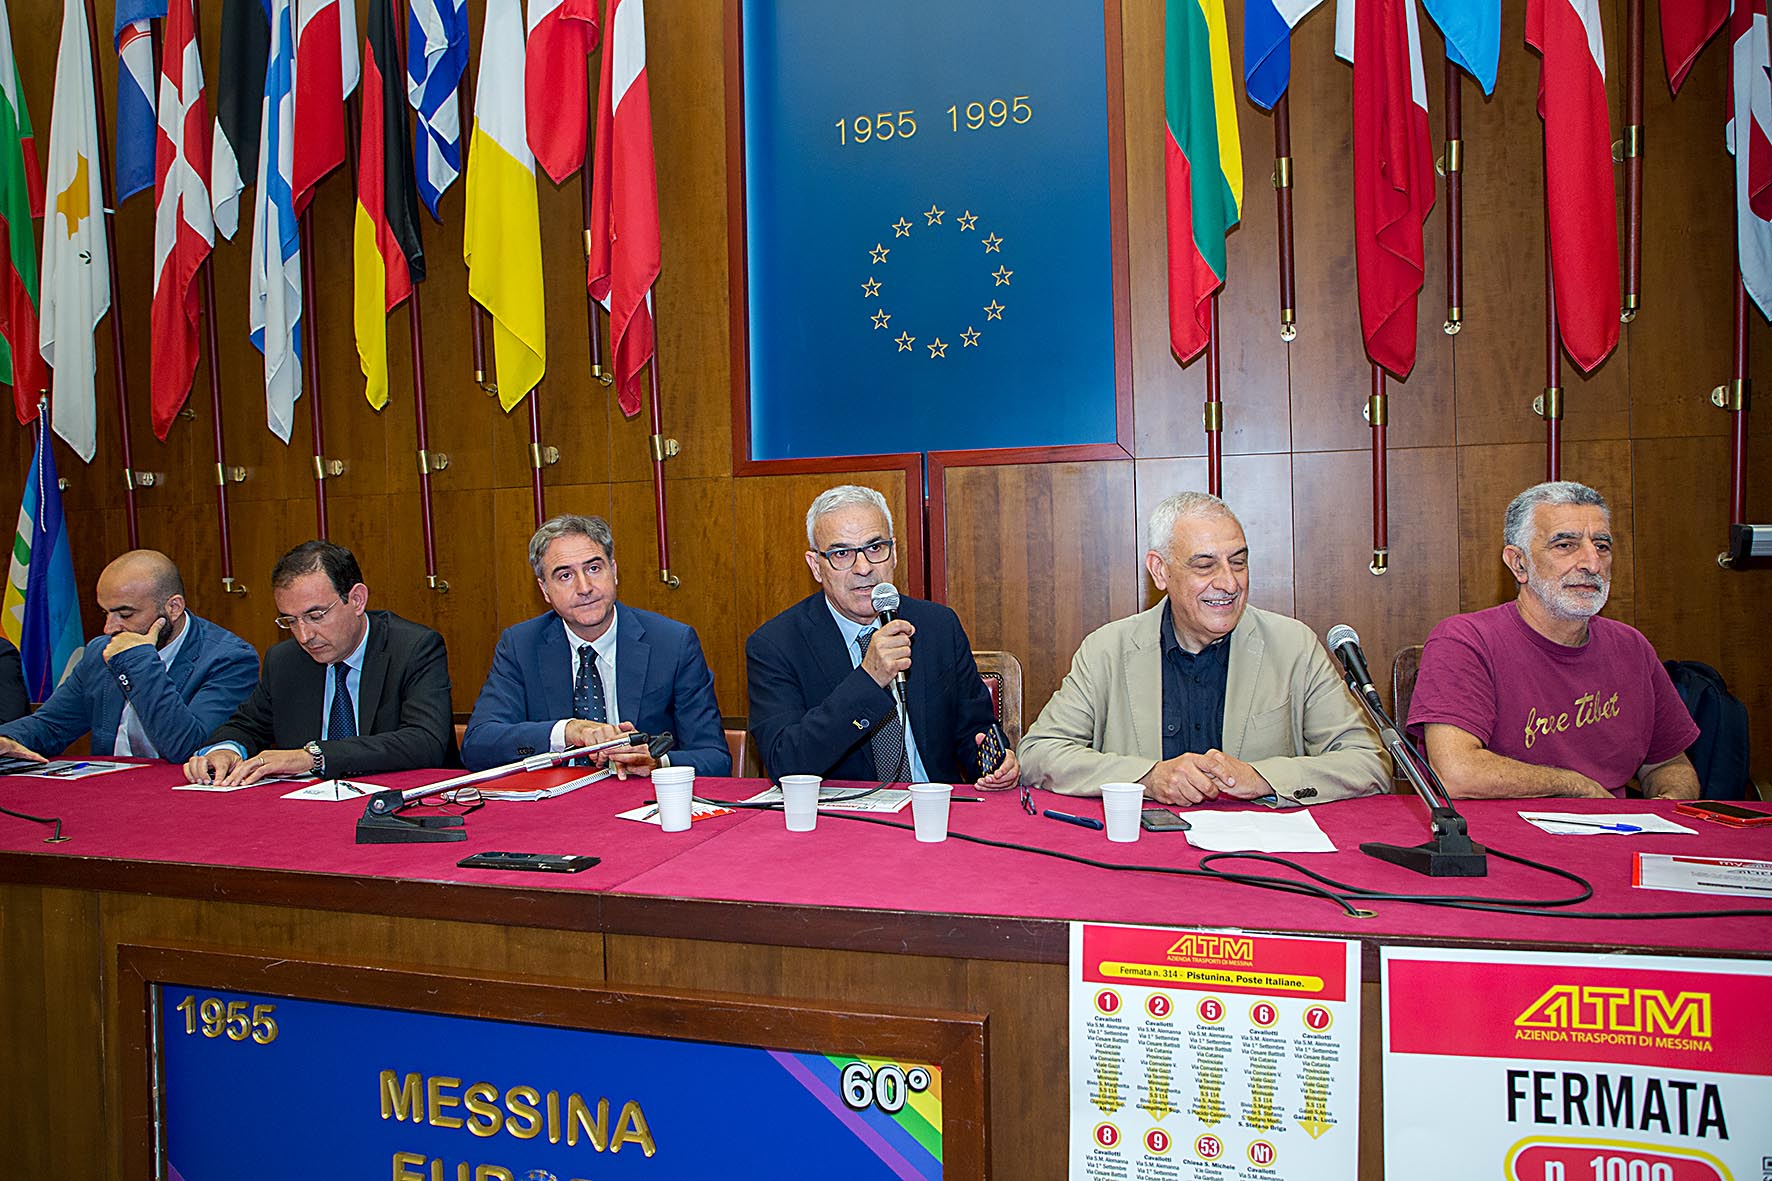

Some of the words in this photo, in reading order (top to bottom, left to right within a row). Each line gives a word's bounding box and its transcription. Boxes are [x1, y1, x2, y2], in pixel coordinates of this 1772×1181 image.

[835, 110, 917, 146] 1955
[947, 96, 1032, 132] 1995
[1524, 707, 1570, 749] free
[1574, 690, 1620, 728] Tibet
[1166, 934, 1254, 960] ATM
[1192, 956, 1221, 965] TRASPORTI
[1120, 966, 1152, 976] Fermata
[1164, 970, 1178, 978] 314
[1187, 972, 1233, 983] Pistunina,
[1236, 975, 1262, 984] Poste
[1265, 976, 1304, 988] Italiane.
[1104, 994, 1110, 1010] 1
[1154, 998, 1164, 1014] 2
[1206, 1002, 1216, 1018] 5
[176, 994, 278, 1044] 1955
[1260, 1006, 1269, 1022] 6
[1312, 1010, 1322, 1026] 7
[1514, 984, 1712, 1038] ATM
[1094, 1016, 1122, 1024] Cavallotti
[1145, 1020, 1174, 1029] Cavallotti
[1196, 1024, 1225, 1033] Cavallotti
[1249, 1029, 1278, 1037] Cavallotti
[1302, 1033, 1332, 1041] Cavallotti
[1515, 1030, 1568, 1042] AZIENDA
[1570, 1032, 1636, 1046] TRASPORTI
[1640, 1036, 1653, 1046] DI
[1655, 1037, 1713, 1052] MESSINA
[1506, 1069, 1730, 1140] FERMATA
[380, 1068, 656, 1158] MESSINA
[1103, 1128, 1112, 1143] 8
[1154, 1133, 1162, 1149] 9
[1094, 1149, 1121, 1158] Cavallotti
[1200, 1140, 1218, 1155] 53
[1254, 1145, 1270, 1162] N1
[1144, 1155, 1172, 1163] Cavallotti
[1212, 1163, 1235, 1171] Michele
[1247, 1167, 1276, 1175] Cavallotti
